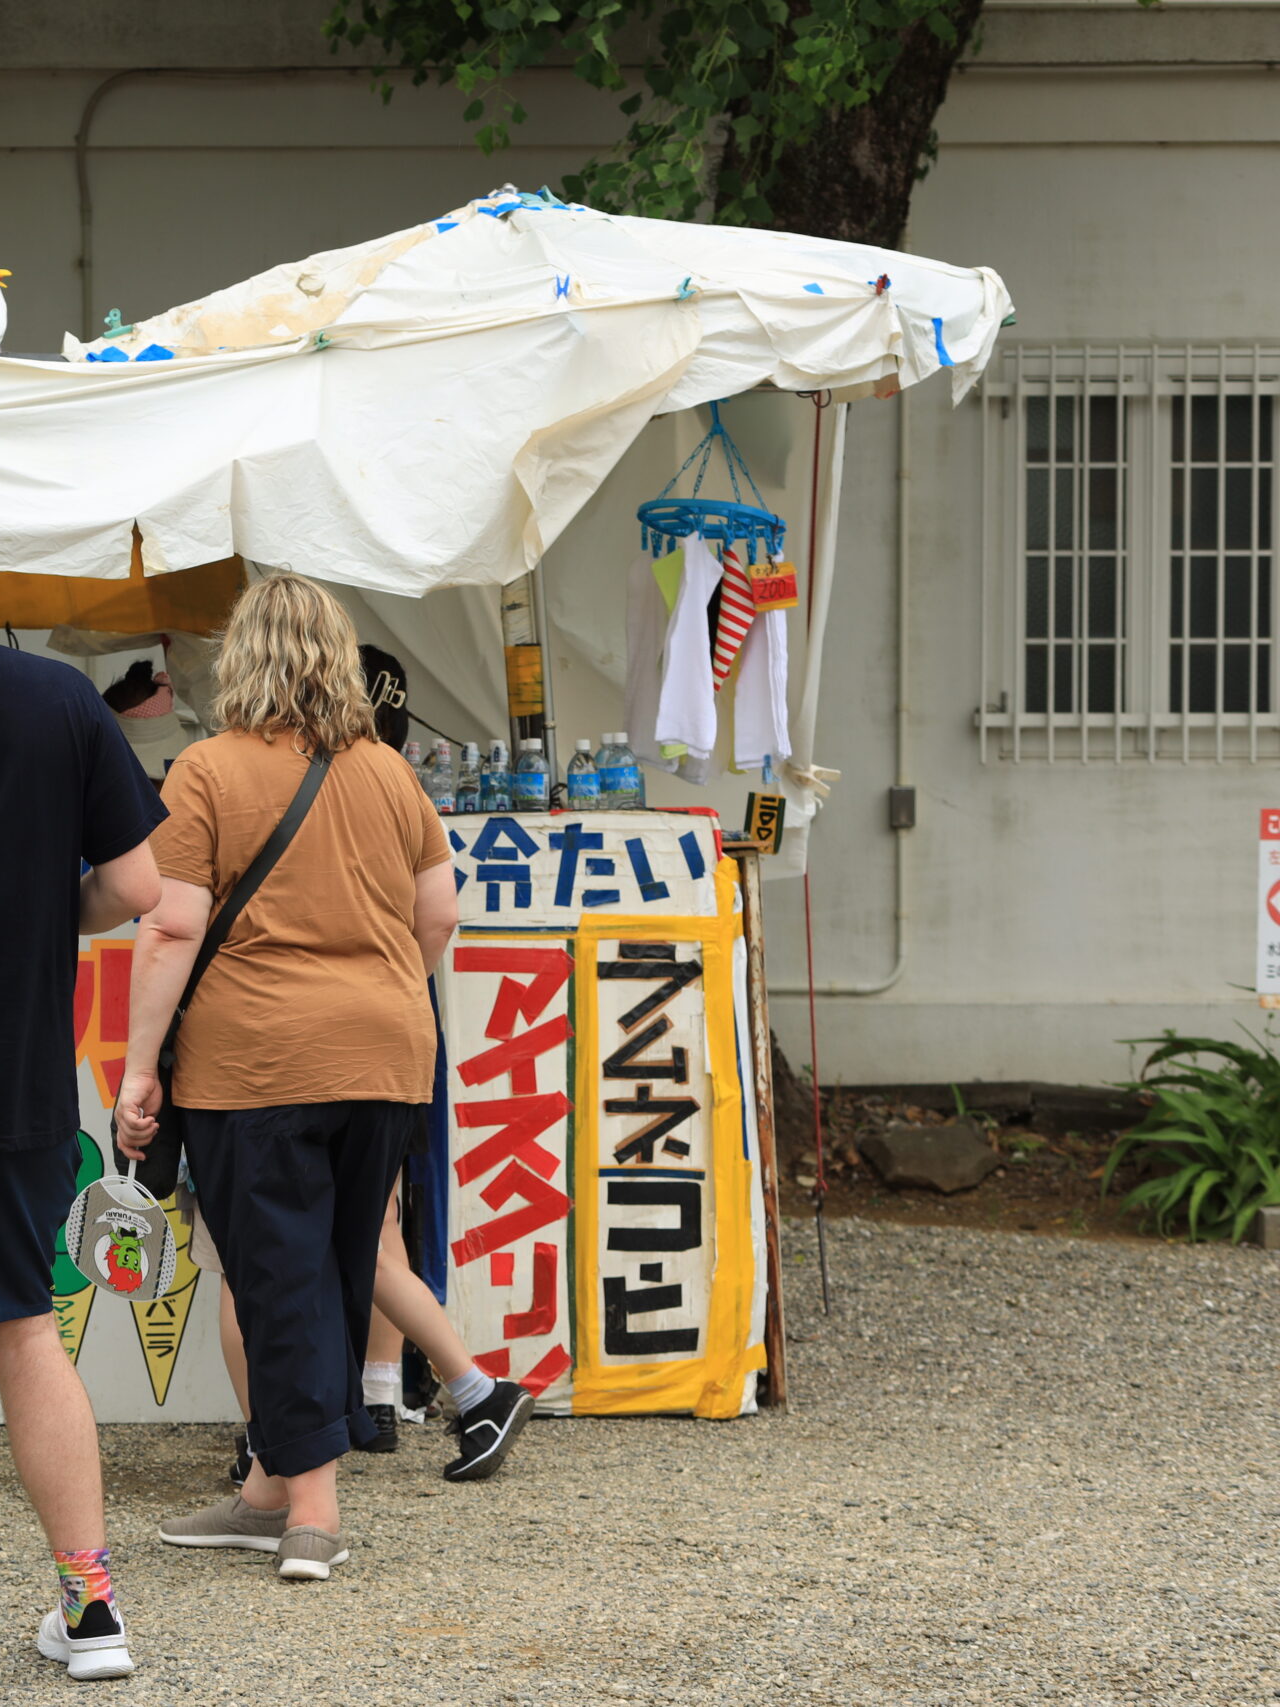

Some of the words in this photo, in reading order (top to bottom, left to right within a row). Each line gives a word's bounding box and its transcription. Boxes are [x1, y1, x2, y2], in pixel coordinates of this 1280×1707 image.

[759, 579, 786, 599] 200
[449, 817, 705, 912] 冷たい
[597, 940, 703, 1165] ラムネ
[451, 947, 576, 1398] アイスクリン
[105, 1210, 132, 1221] FURARI
[145, 1299, 178, 1358] バニラ
